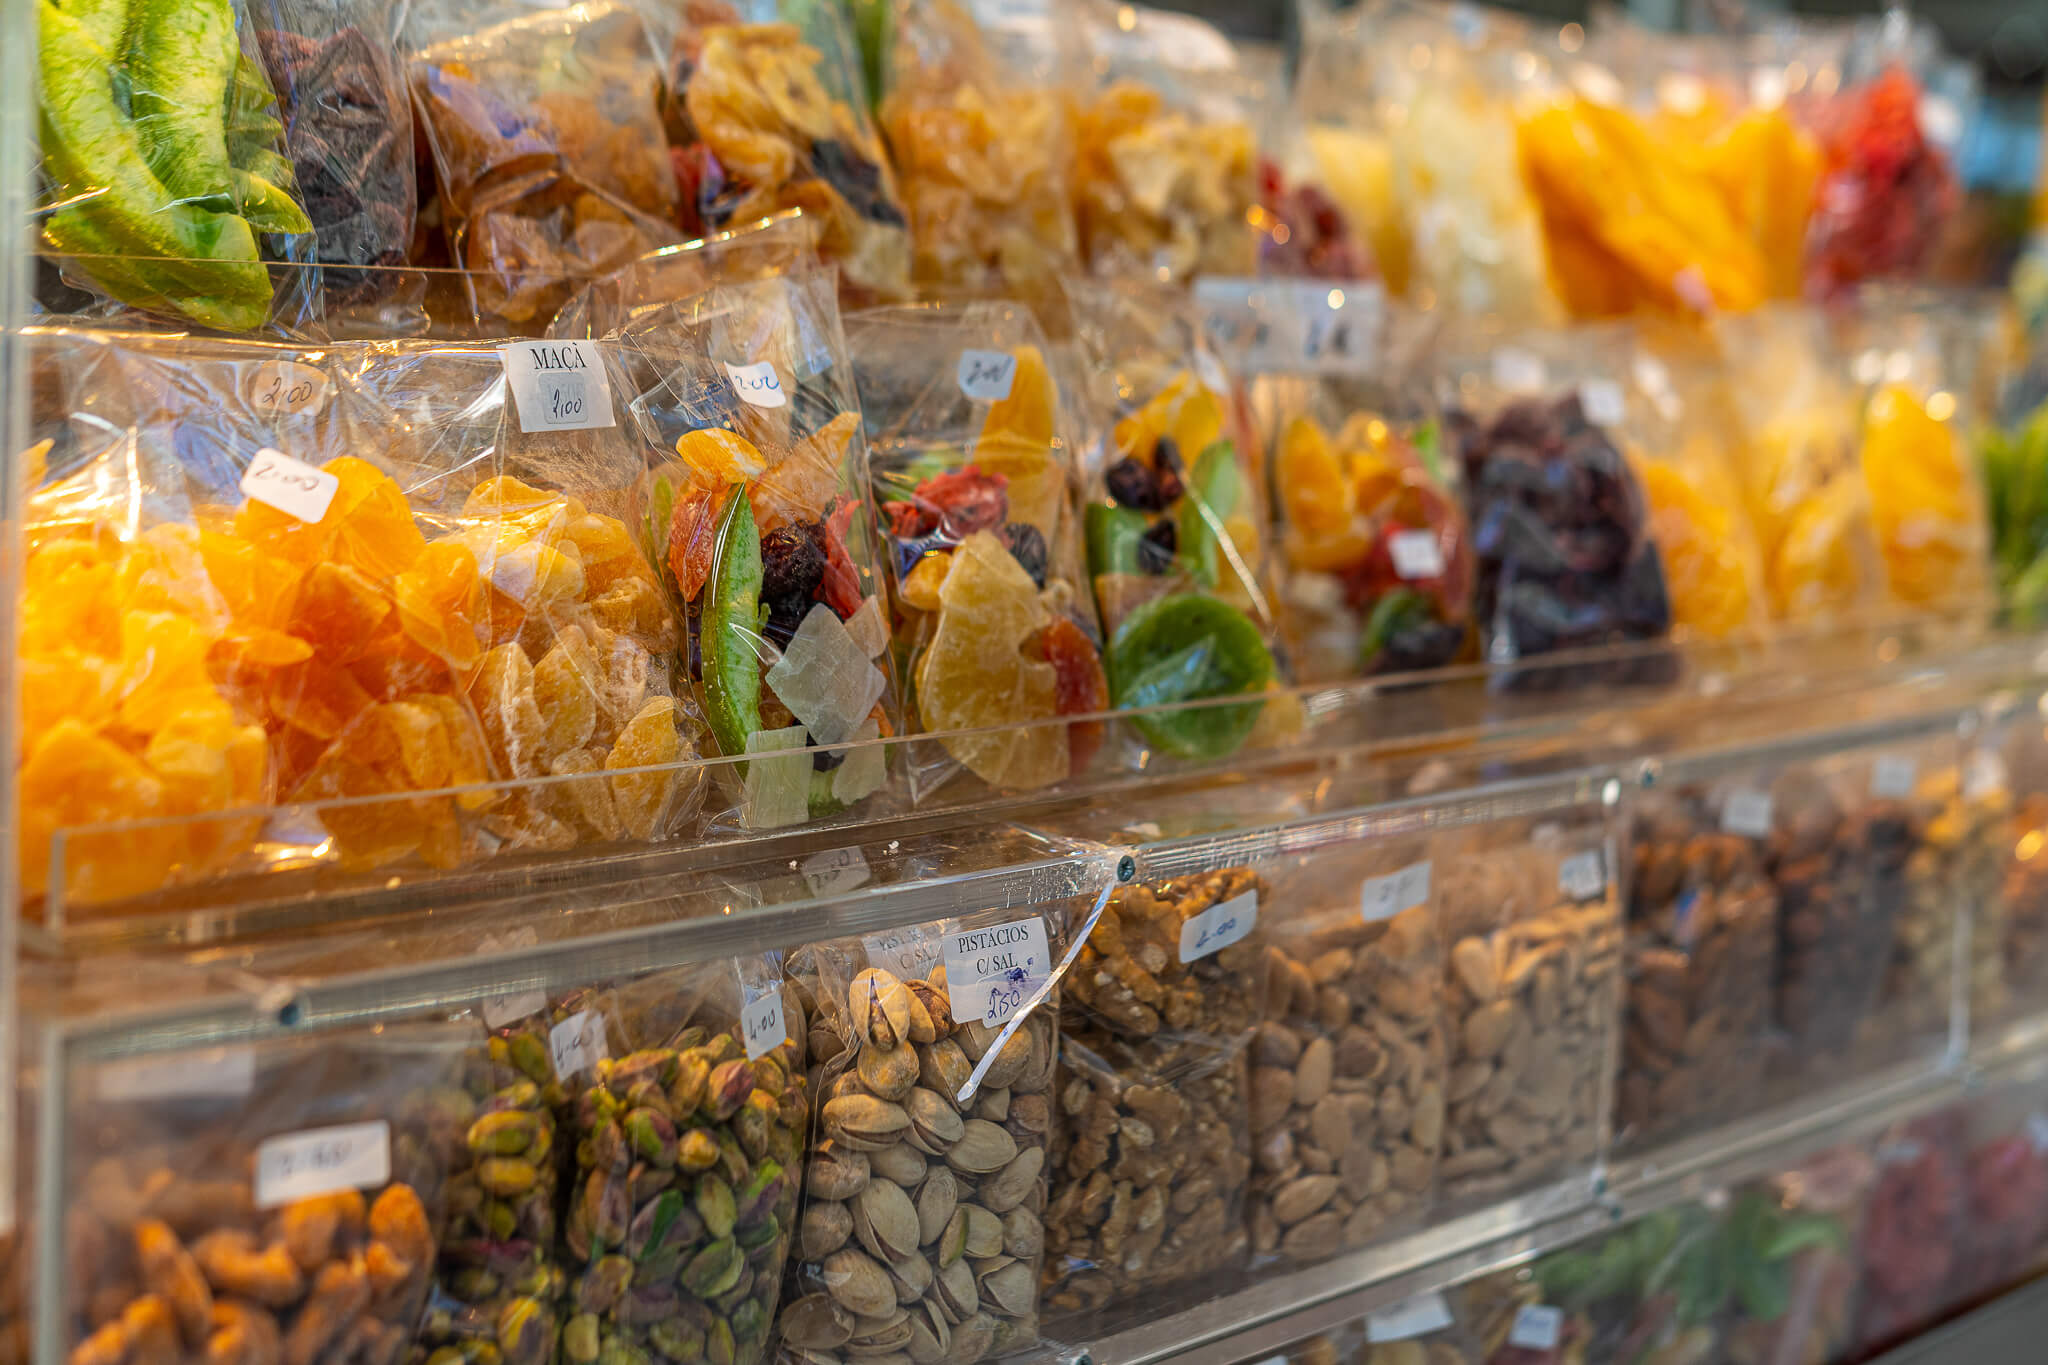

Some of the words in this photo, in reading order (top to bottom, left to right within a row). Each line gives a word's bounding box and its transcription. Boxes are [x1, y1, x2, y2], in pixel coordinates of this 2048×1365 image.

[958, 925, 1029, 953] PISTÁCIOS
[976, 956, 990, 976] C/
[992, 952, 1018, 972] SAL
